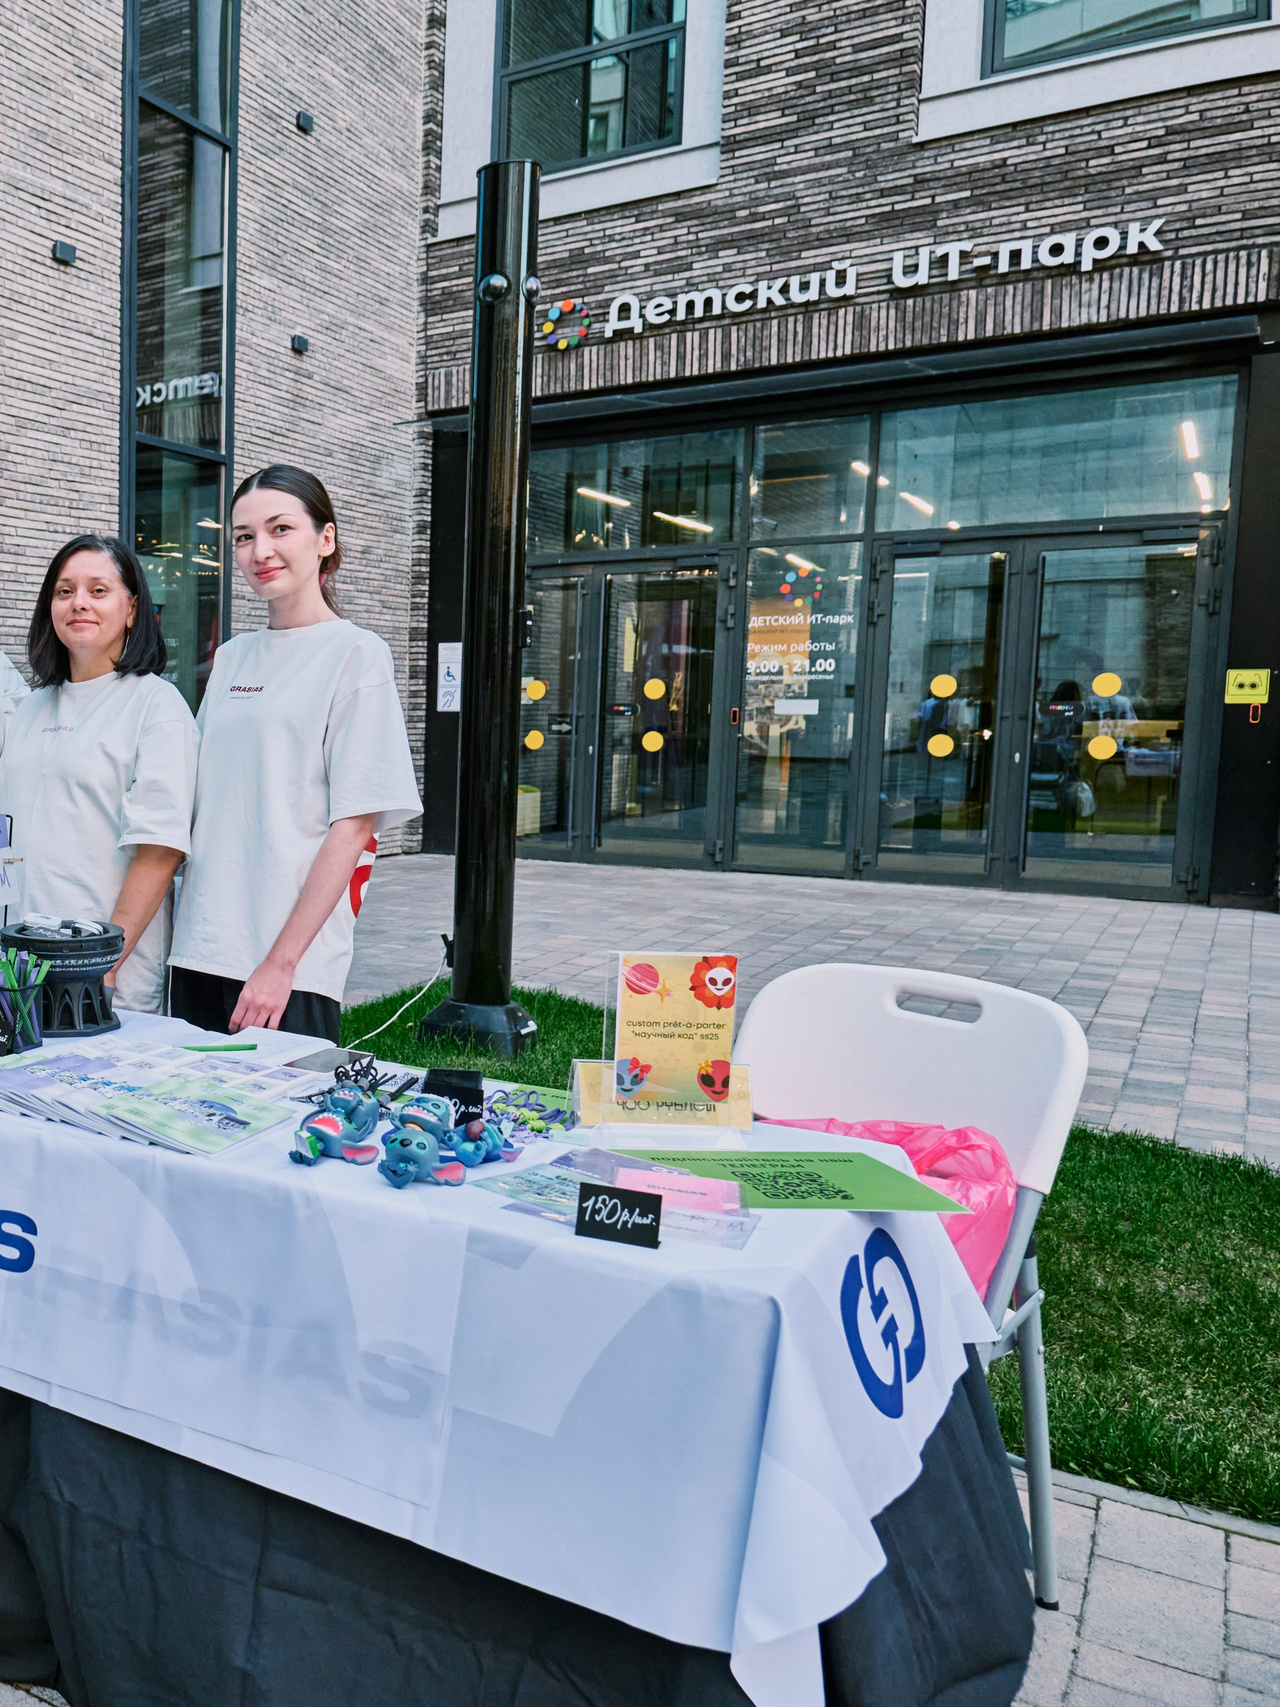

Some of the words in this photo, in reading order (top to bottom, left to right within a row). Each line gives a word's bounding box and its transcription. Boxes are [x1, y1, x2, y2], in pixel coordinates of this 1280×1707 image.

[604, 258, 858, 338] Детский
[892, 217, 1166, 288] ИТ-парк
[748, 612, 804, 628] ДЕТСКИЙ
[807, 613, 854, 625] ИТ-парк
[747, 642, 787, 653] Режим
[790, 640, 835, 653] работы
[746, 659, 779, 673] 9.00
[792, 659, 836, 672] 21.00
[663, 1020, 726, 1030] prêt-à-porter
[631, 1030, 675, 1039] "научный
[677, 1032, 698, 1040] код"
[650, 1156, 790, 1164] подписывайтесь
